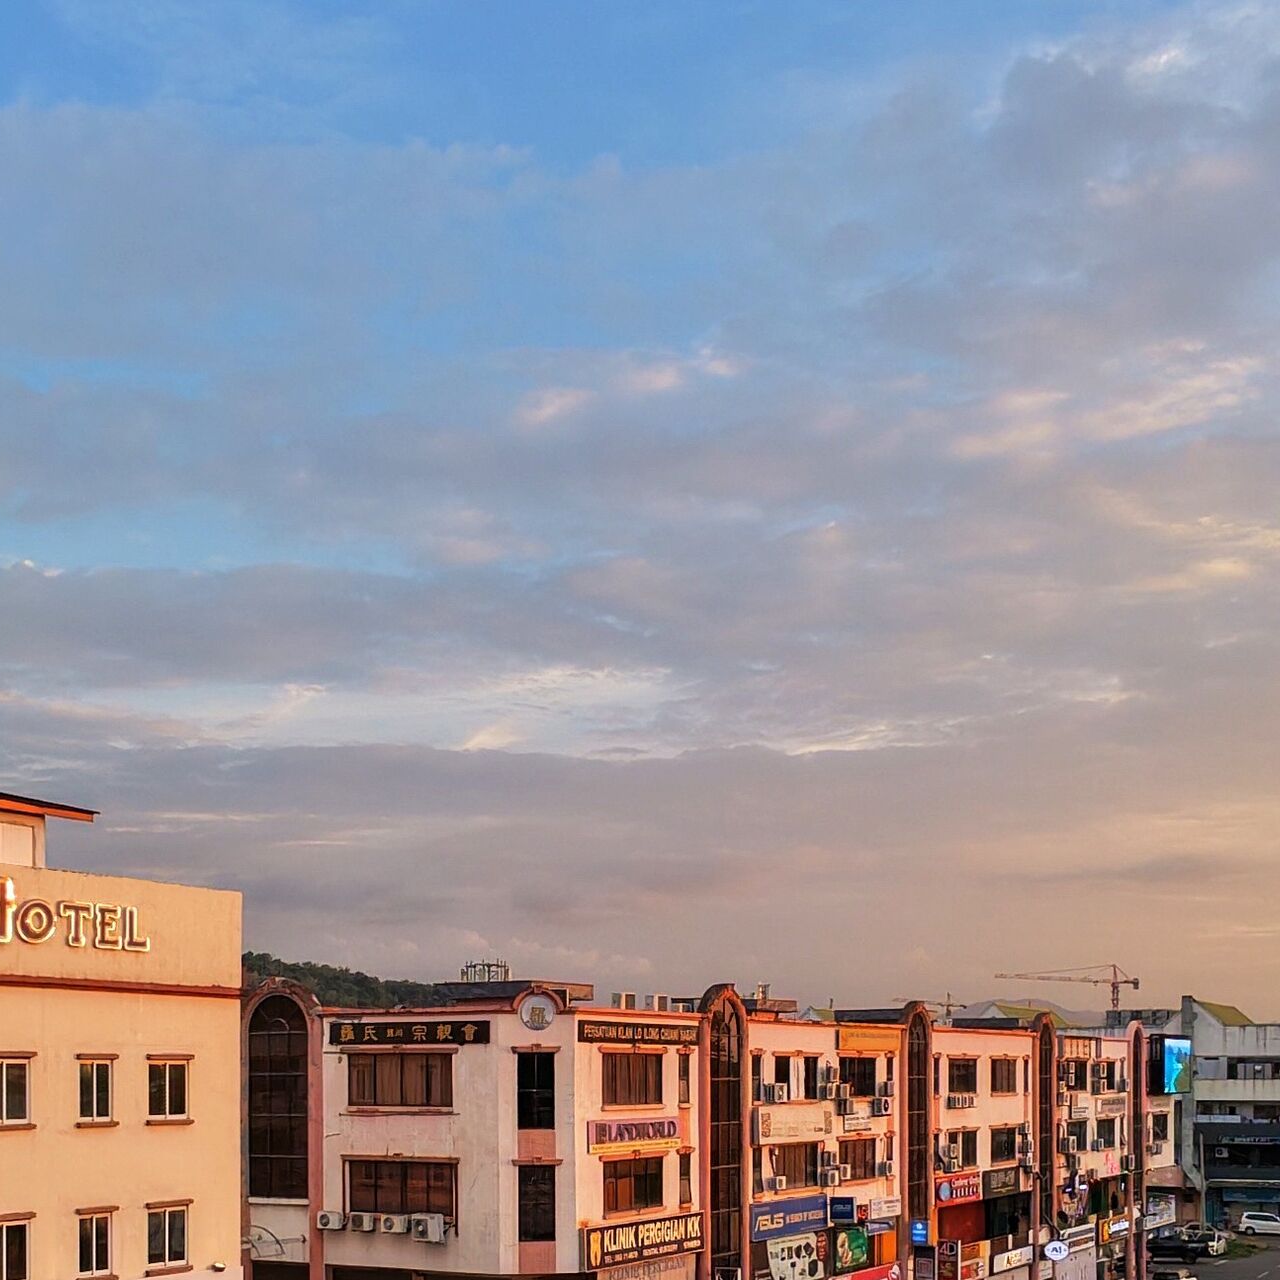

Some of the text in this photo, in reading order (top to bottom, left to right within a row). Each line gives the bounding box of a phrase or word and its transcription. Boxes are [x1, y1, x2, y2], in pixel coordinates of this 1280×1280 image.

[604, 1216, 701, 1253] KLINIK PERGIGIAN KK
